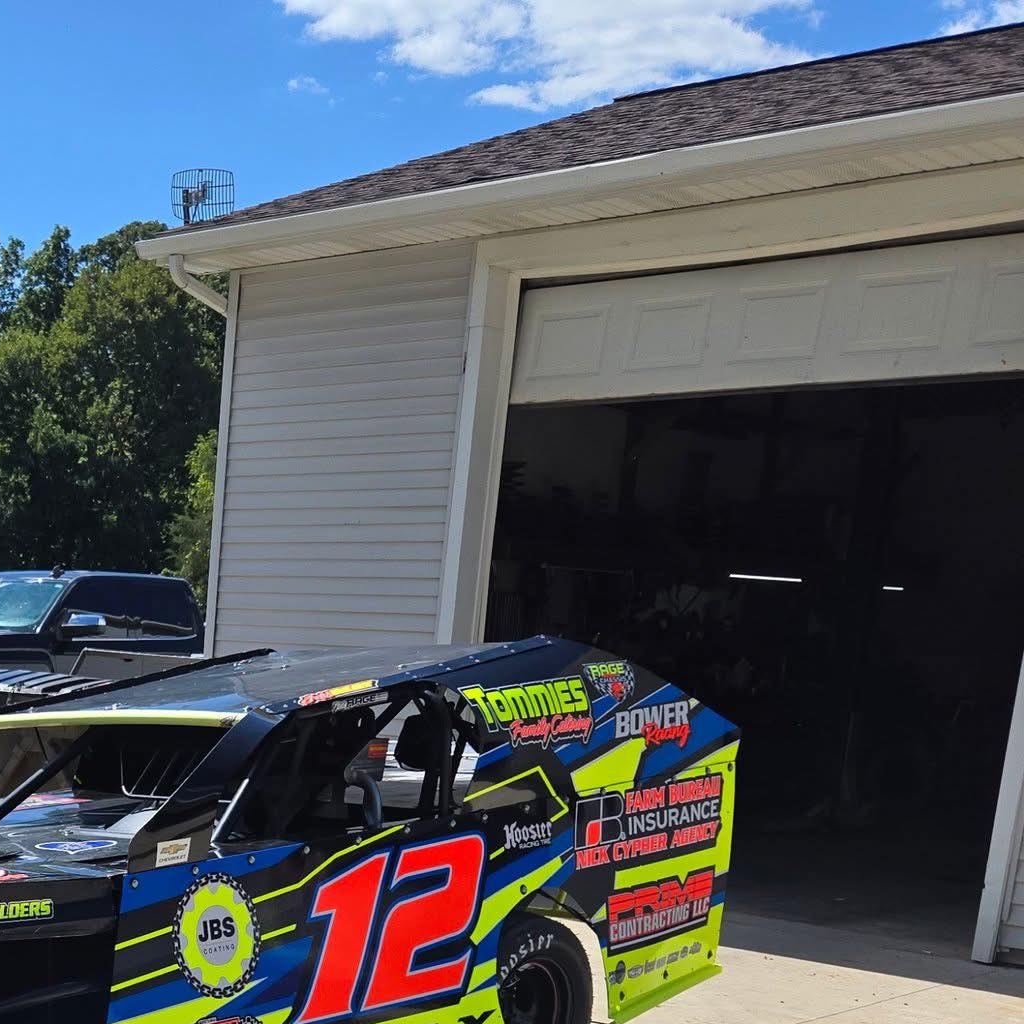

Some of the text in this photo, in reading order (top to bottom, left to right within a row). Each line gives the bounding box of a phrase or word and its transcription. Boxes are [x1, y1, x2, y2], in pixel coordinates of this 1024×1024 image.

[589, 662, 625, 678] RAGE
[462, 679, 589, 725] TOMMIES
[509, 713, 593, 741] Family Catering
[615, 700, 690, 739] BOWER
[641, 722, 690, 748] Racing
[625, 775, 721, 814] FARM BUREAU
[628, 799, 719, 836] INSURANCE
[503, 821, 553, 849] Hoosier
[576, 821, 720, 870] NICK CYPHER AGENCY
[158, 854, 187, 863] CHEVROLET
[198, 916, 236, 943] JBS
[610, 896, 710, 942] CONTRACTING LLC
[203, 943, 235, 955] COATING
[499, 934, 554, 986] oosier
